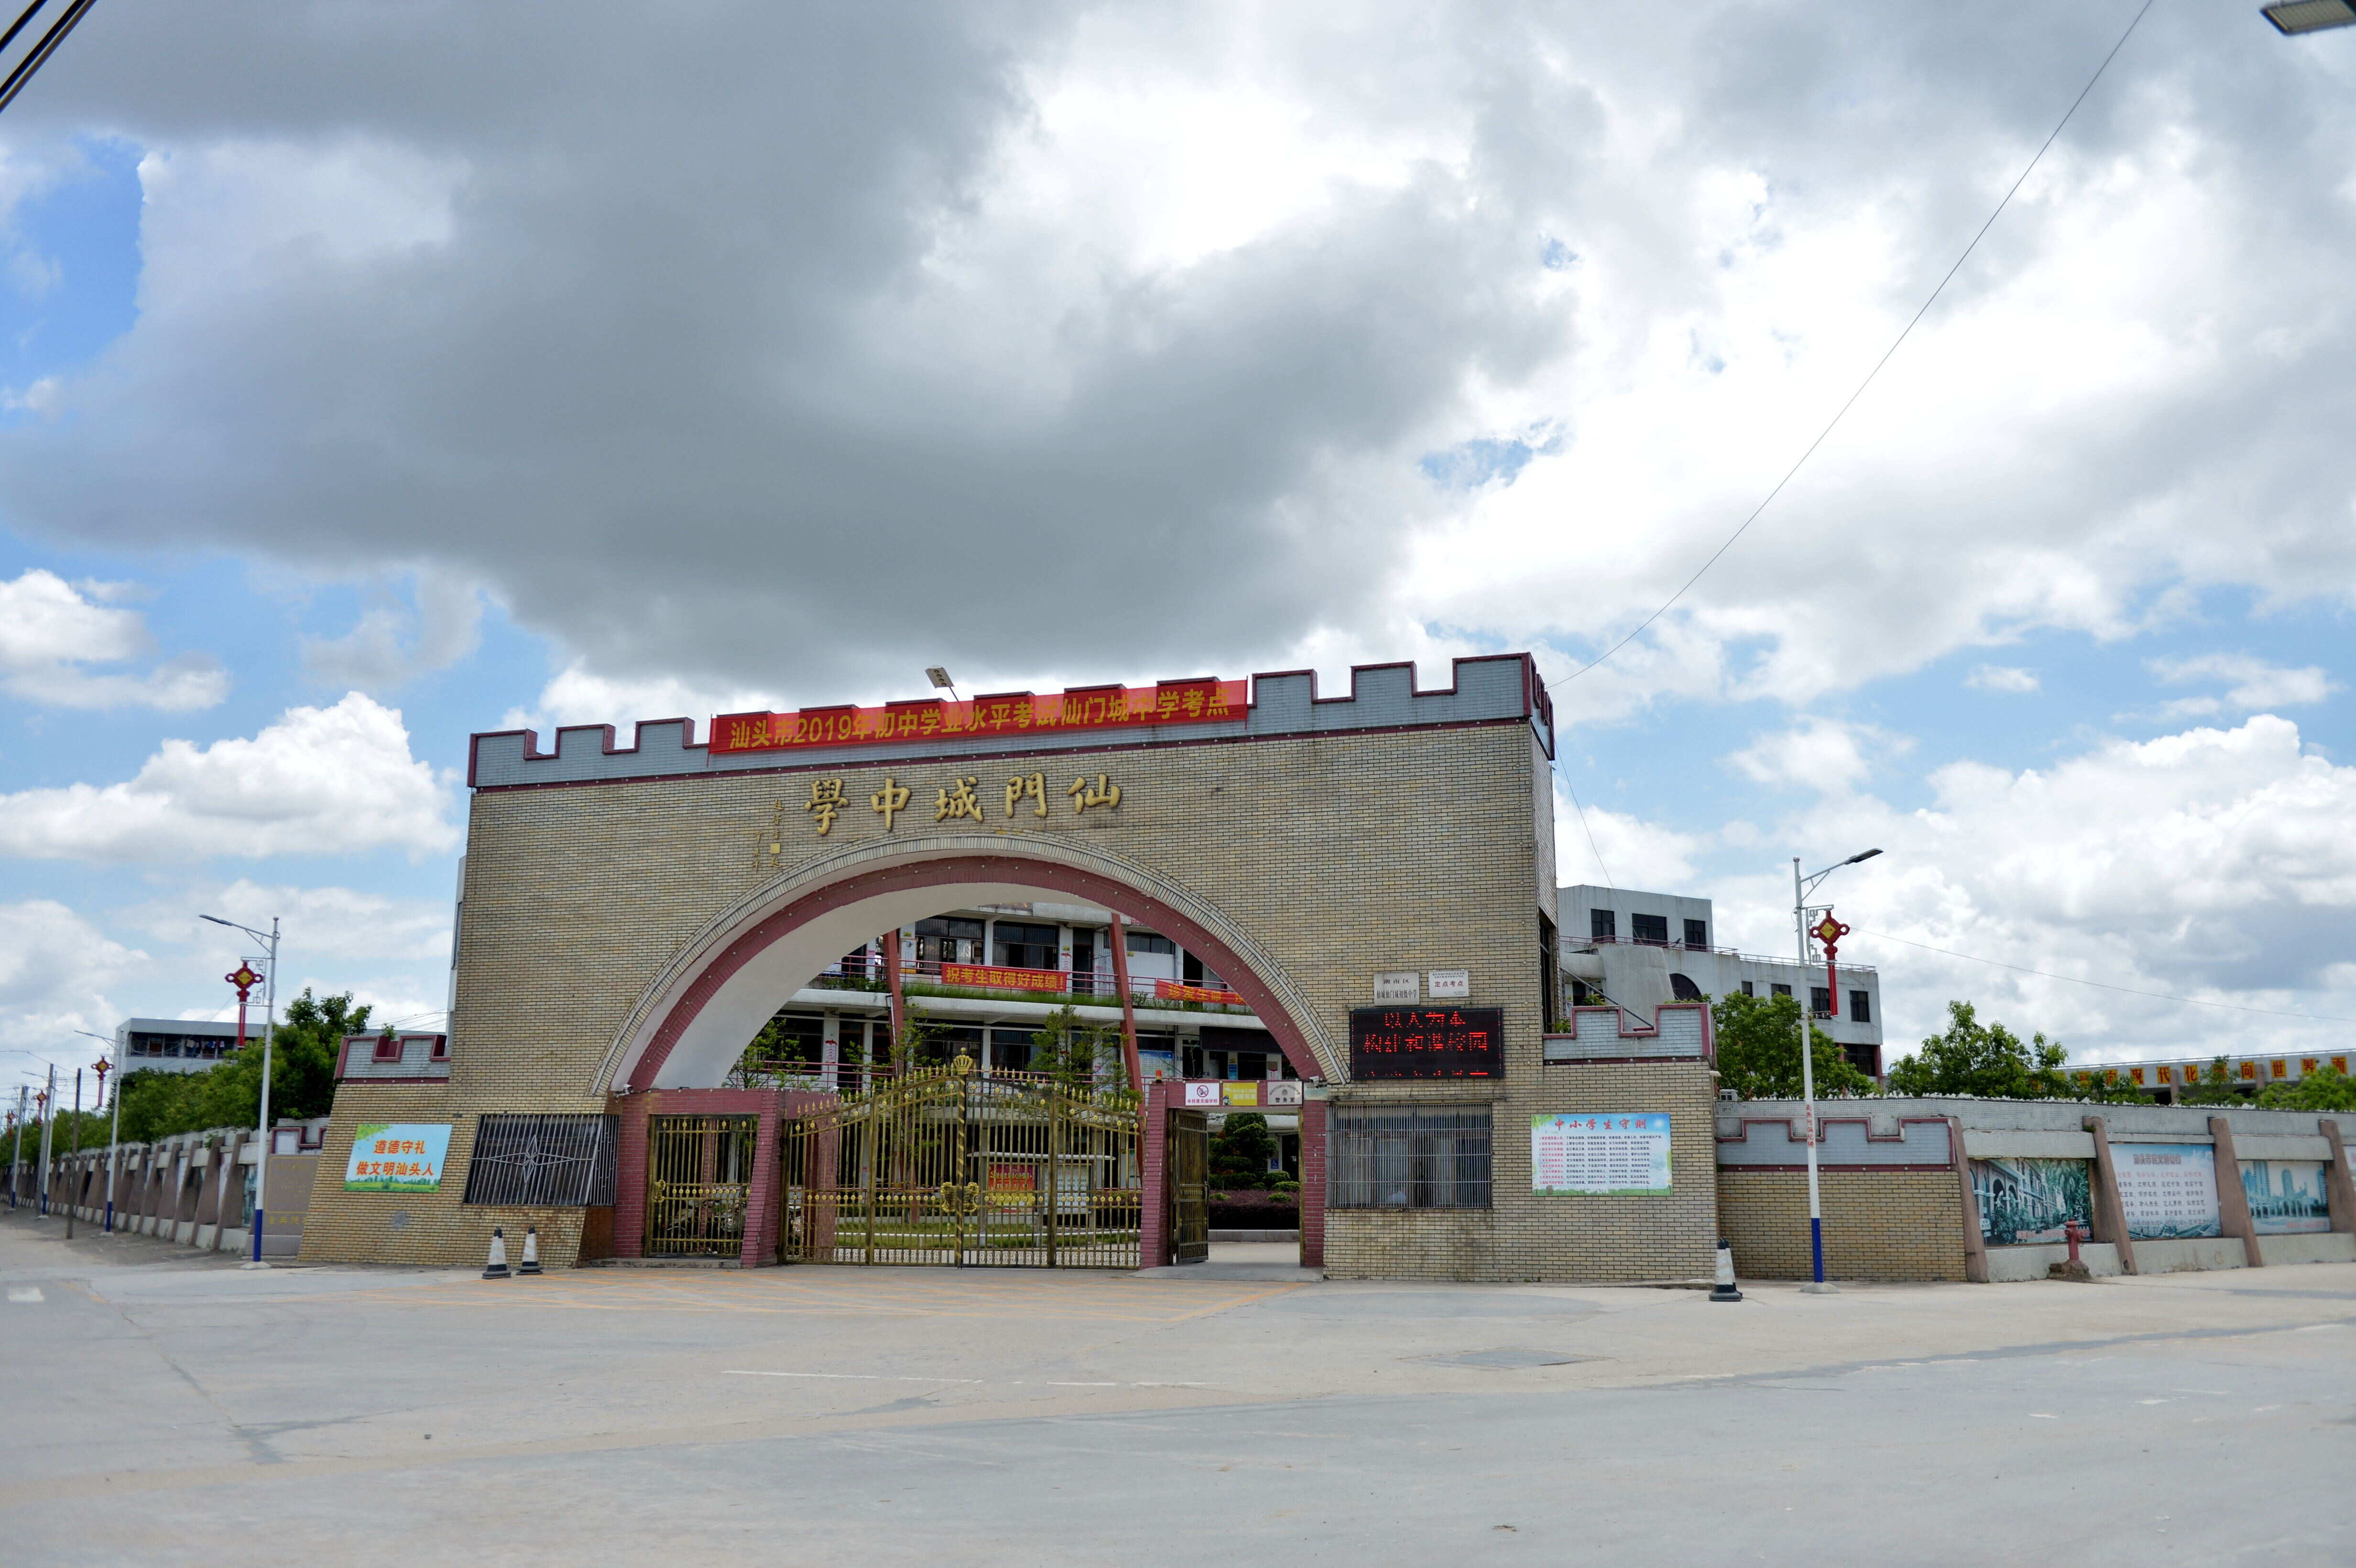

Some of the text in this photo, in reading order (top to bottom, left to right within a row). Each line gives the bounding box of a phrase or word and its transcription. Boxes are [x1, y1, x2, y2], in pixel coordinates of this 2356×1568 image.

[730, 688, 1229, 749] 汕头市2019年初中学业水平考试仙门城中学考点
[1385, 1011, 1466, 1028] 以人为本
[1363, 1032, 1489, 1053] 构建和谐校园
[1555, 1118, 1647, 1131] 中小学生守则
[356, 1161, 434, 1176] 做文明汕头人
